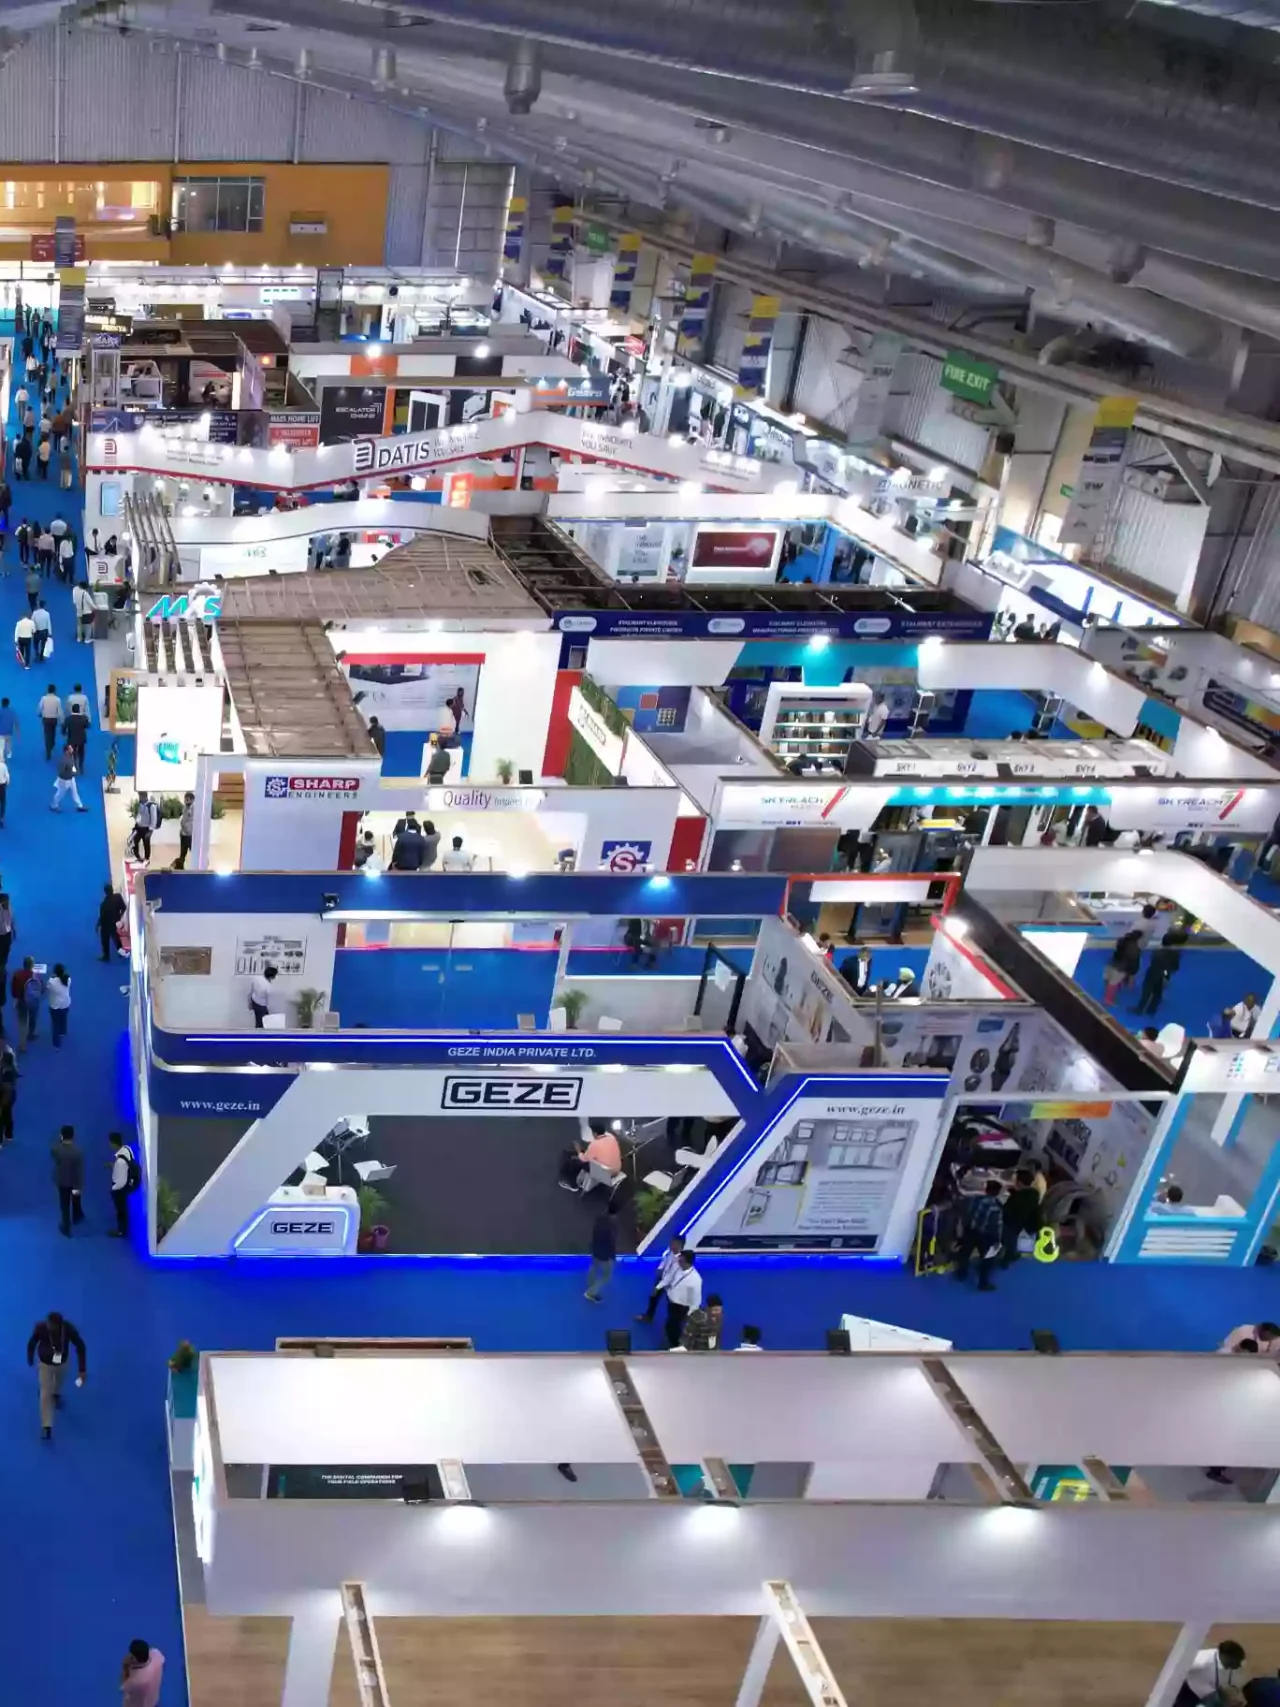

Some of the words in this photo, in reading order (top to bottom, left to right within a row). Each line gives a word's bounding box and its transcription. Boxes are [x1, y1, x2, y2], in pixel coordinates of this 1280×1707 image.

[945, 364, 967, 383] FIRE
[966, 372, 991, 391] EXIT
[379, 442, 430, 468] DATIS
[293, 779, 357, 790] SHARP
[443, 790, 492, 809] Quality
[448, 1047, 480, 1057] GEZE
[484, 1047, 516, 1057] INDIA
[519, 1048, 569, 1058] PRIVATE
[571, 1048, 597, 1058] LTD.
[450, 1082, 575, 1105] GEZE
[180, 1100, 261, 1112] www.geze.in
[827, 1104, 906, 1116] www.geze.in
[273, 1222, 332, 1234] GEZE
